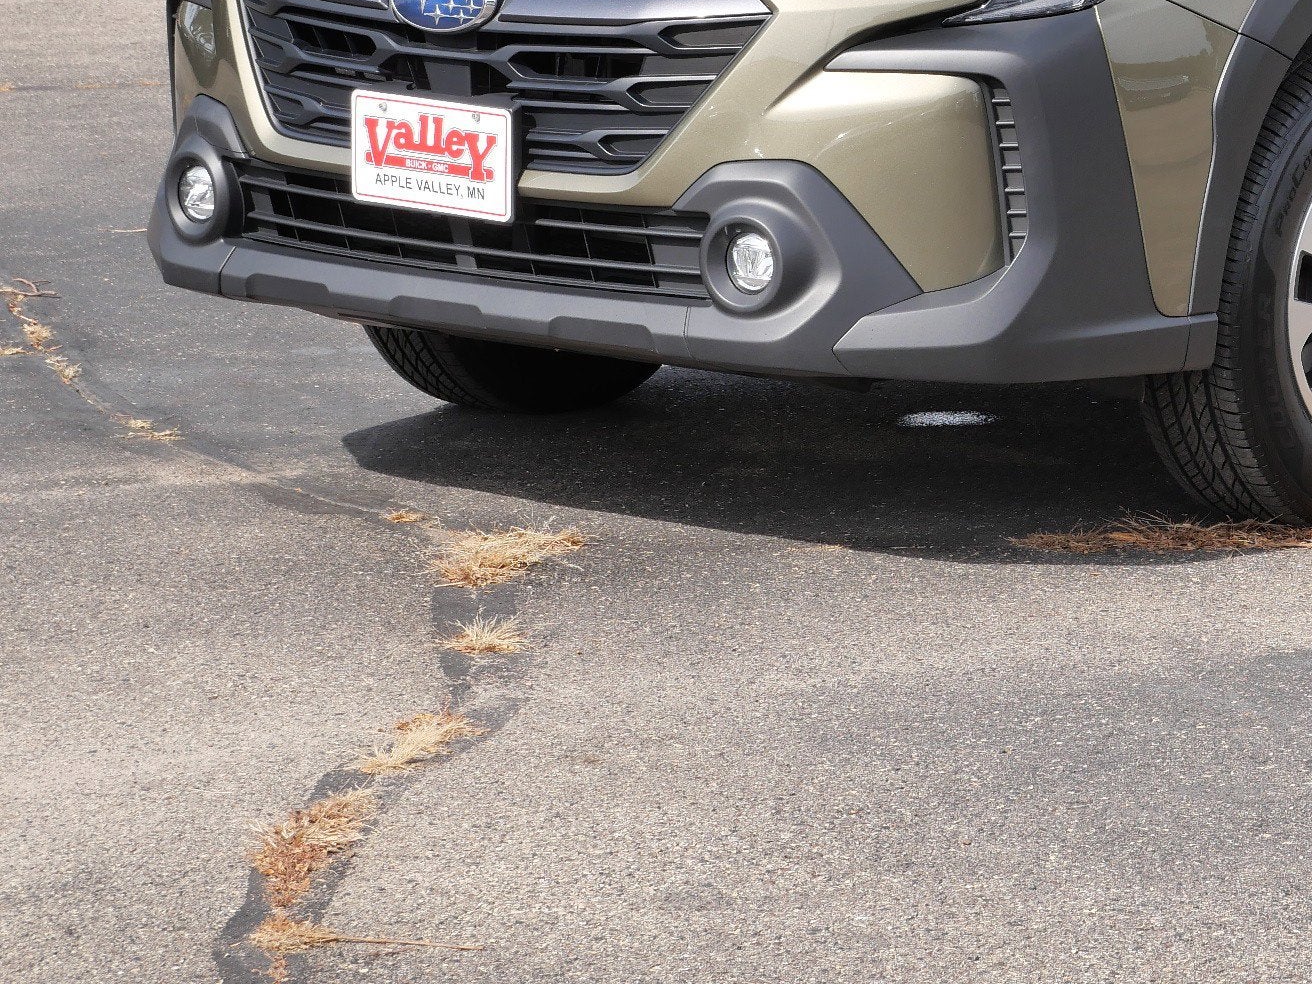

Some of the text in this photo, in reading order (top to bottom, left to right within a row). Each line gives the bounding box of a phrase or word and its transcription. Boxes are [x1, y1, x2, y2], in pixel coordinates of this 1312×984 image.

[364, 114, 497, 182] Valley
[405, 158, 449, 173] BUICK GMC
[375, 173, 485, 200] APPLE VALLEY, MN
